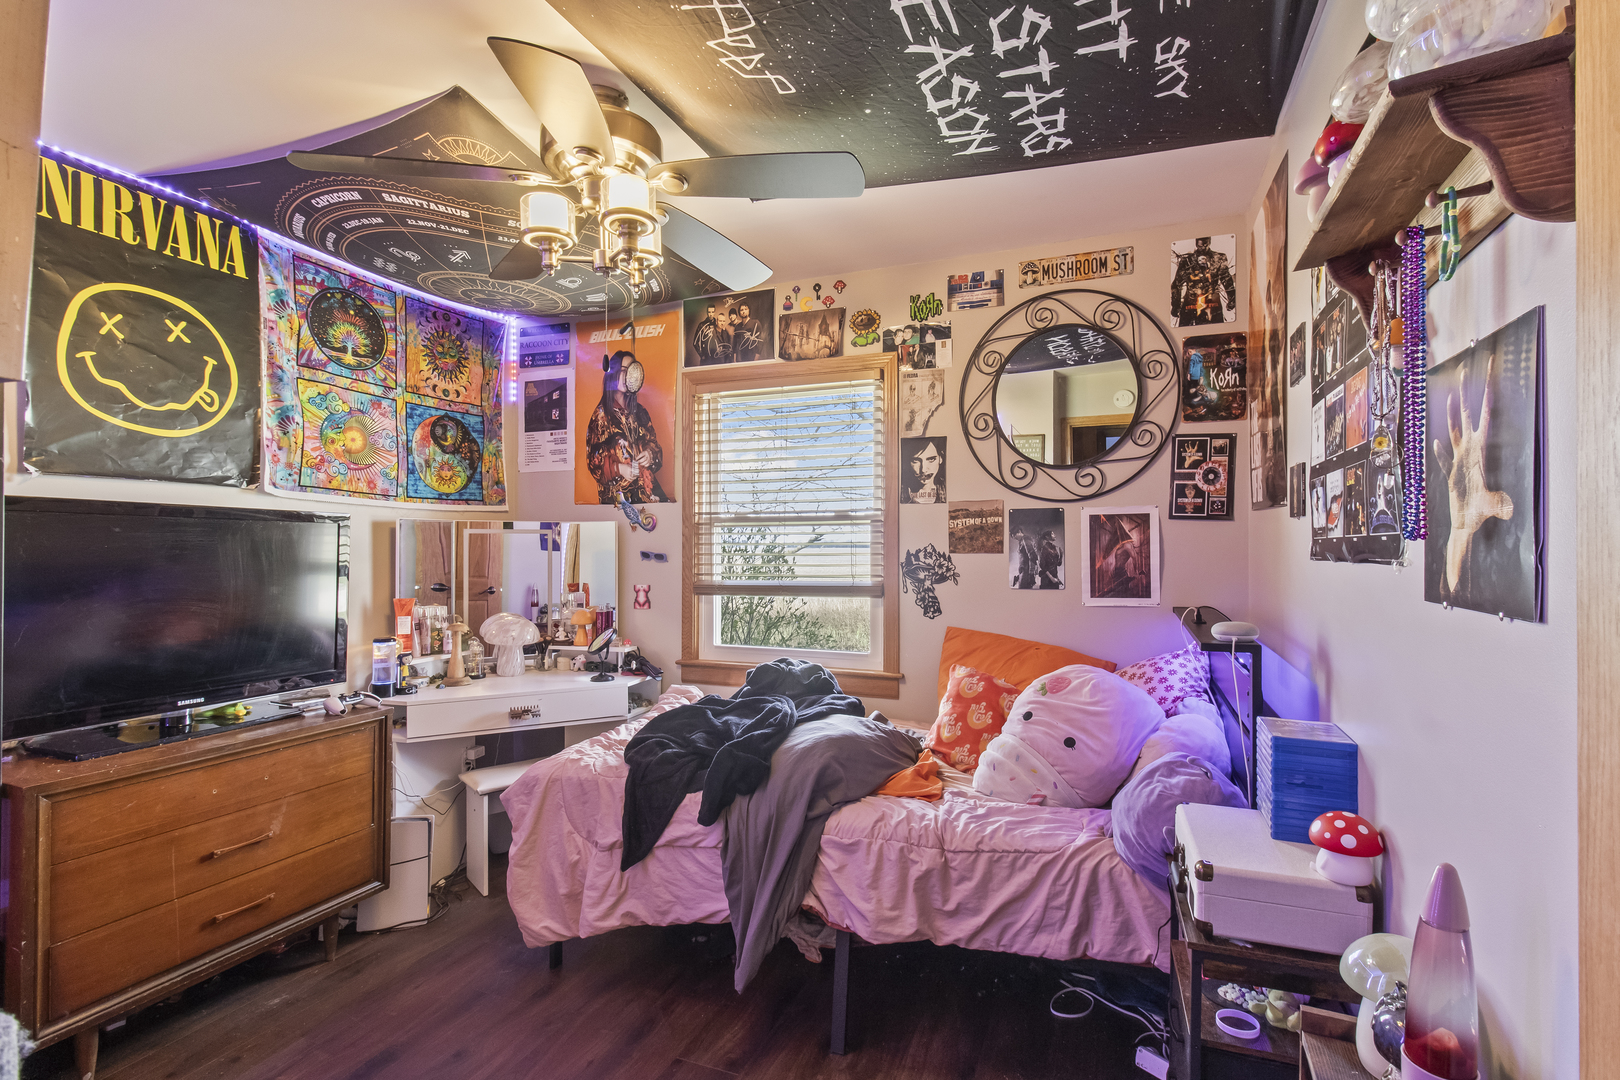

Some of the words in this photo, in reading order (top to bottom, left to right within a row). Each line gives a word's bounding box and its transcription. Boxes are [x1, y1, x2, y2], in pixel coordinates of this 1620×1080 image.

[989, 4, 1073, 157] STARS
[1154, 36, 1191, 98] SKY
[311, 191, 363, 208] CAPRICORN
[382, 192, 471, 219] SAGITTARIUS
[37, 156, 249, 280] NIRVANA
[1042, 256, 1108, 280] MUSHROOM
[1114, 253, 1128, 271] ST
[520, 340, 552, 348] RACCOON
[949, 518, 974, 528] SYSTEM
[178, 698, 204, 706] SAMSUNG
